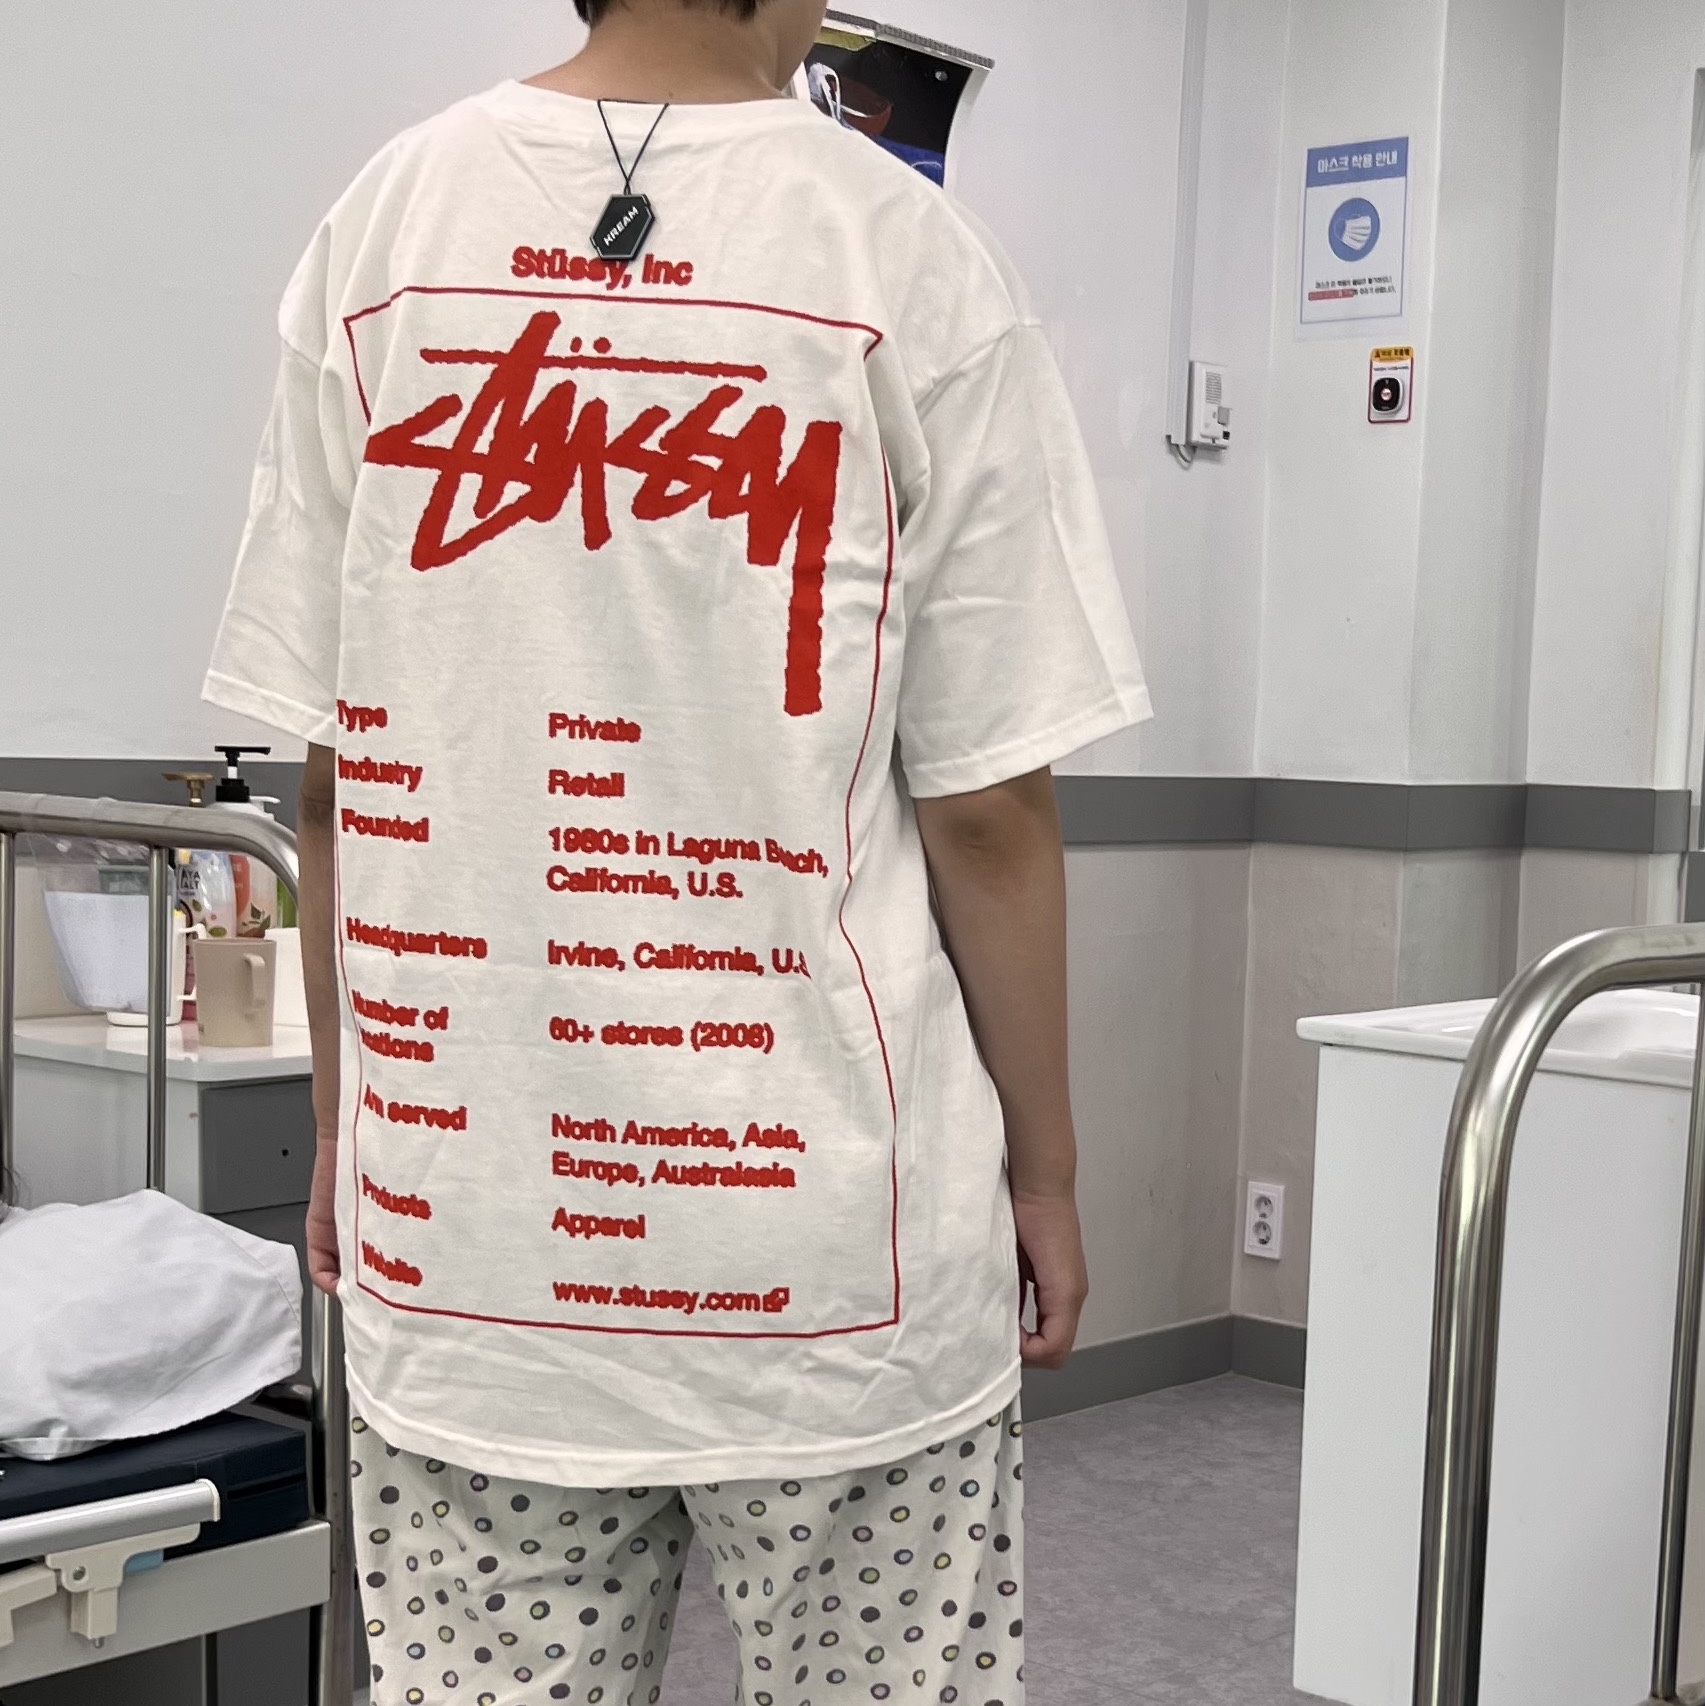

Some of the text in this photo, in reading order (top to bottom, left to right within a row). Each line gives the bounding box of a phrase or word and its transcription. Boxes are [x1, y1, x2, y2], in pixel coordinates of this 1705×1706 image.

[1317, 156, 1349, 173] 마스크
[1375, 150, 1398, 167] 안내
[603, 205, 639, 246] KREAM
[641, 253, 694, 287] Inc
[336, 698, 388, 733] Type
[547, 712, 641, 744] Private
[337, 755, 423, 793] Industry
[547, 769, 626, 799] Retail
[340, 808, 430, 843] Founded
[549, 827, 630, 855] 1980s
[635, 830, 661, 857] in
[666, 832, 762, 866] Laguna
[546, 864, 743, 900] California, U.S.
[345, 917, 488, 959] Headquarters
[547, 940, 626, 972] Irvine,
[633, 942, 765, 977] California,
[423, 1006, 449, 1031] of
[549, 1016, 775, 1055] 60+ stores (2008)
[388, 1101, 468, 1132] served
[551, 1114, 806, 1153] North America, Asia,
[551, 1151, 796, 1189] Europe, Australasia
[552, 1207, 646, 1240] Apparel
[553, 1282, 761, 1315] www.stussy.com
